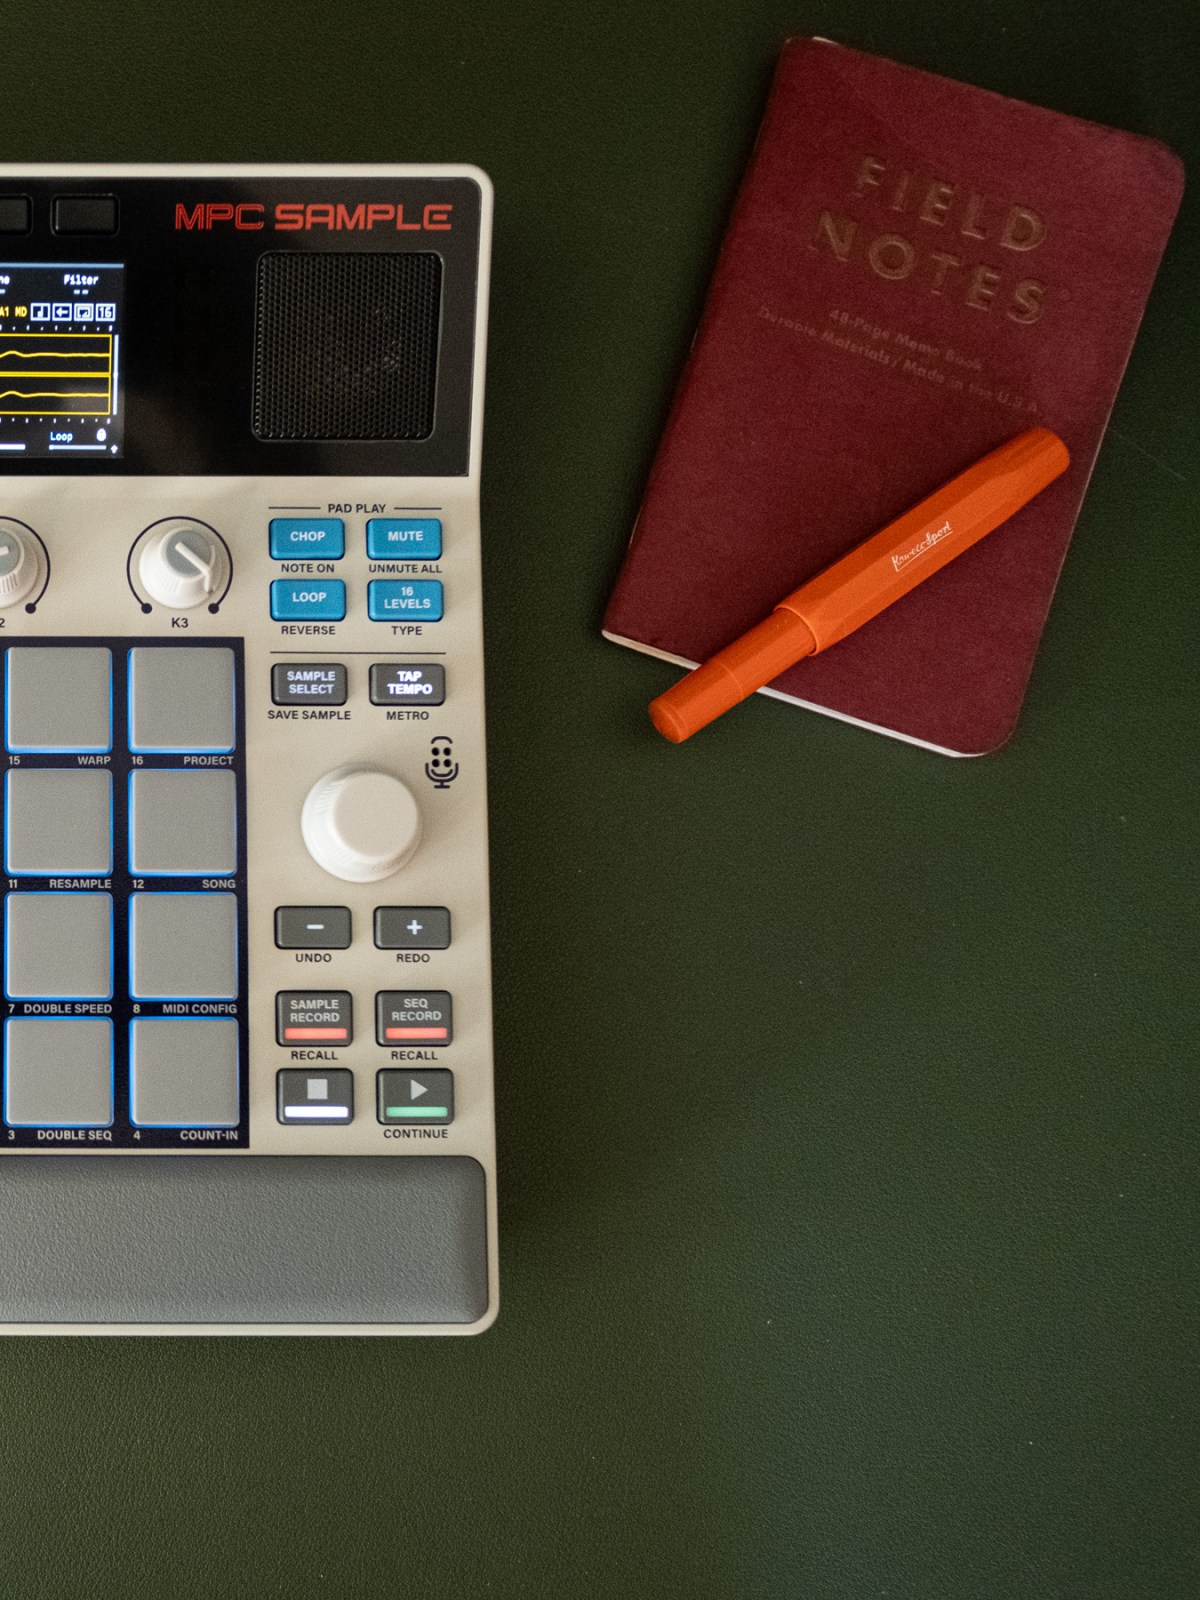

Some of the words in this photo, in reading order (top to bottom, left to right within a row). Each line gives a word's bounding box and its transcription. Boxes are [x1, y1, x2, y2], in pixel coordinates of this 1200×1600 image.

[851, 154, 1047, 252] FIELD
[175, 203, 264, 231] MPC
[275, 204, 453, 231] SAMPLE
[808, 209, 1048, 325] NOTES
[64, 274, 100, 286] Filter
[99, 306, 112, 318] 16
[50, 431, 74, 444] Loop
[328, 504, 352, 514] PAD
[355, 504, 386, 514] PLAY
[290, 531, 326, 542] CHOP
[388, 531, 424, 542] MUTE
[281, 563, 314, 573] NOTE
[316, 563, 335, 573] ON
[368, 564, 418, 574] UNMUTE
[421, 564, 442, 574] ALL
[400, 586, 414, 596] 16
[292, 592, 327, 602] LOOP
[384, 598, 431, 609] LEVELS
[171, 618, 189, 628] K3
[281, 625, 336, 636] REVERSE
[391, 626, 423, 636] TYPE
[286, 671, 336, 682] SAMPLE
[396, 670, 422, 682] TAP
[288, 684, 334, 694] SELECT
[387, 684, 433, 695] TEMPO
[268, 710, 299, 720] SAVE
[302, 710, 351, 720] SAMPLE
[386, 711, 429, 721] METRO
[8, 756, 20, 766] 15
[77, 756, 112, 766] WARP
[131, 756, 144, 766] 16
[183, 756, 234, 766] PROJECT
[8, 879, 18, 889] 11
[49, 879, 112, 889] RESAMPLE
[132, 879, 144, 889] 12
[202, 879, 236, 889] SONG
[295, 953, 332, 963] UNDO
[396, 953, 430, 963] REDO
[8, 1004, 15, 1014] 7
[23, 1004, 72, 1014] DOUBLE
[74, 1004, 112, 1014] SPEED
[133, 1004, 140, 1014] 8
[162, 1004, 189, 1014] MIDI
[191, 1004, 238, 1014] CONFIG
[290, 1000, 339, 1010] SAMPLE
[403, 998, 429, 1010] SEQ
[290, 1012, 340, 1022] RECORD
[391, 1011, 442, 1021] RECORD
[291, 1050, 338, 1060] RECALL
[391, 1050, 438, 1060] RECALL
[8, 1130, 15, 1140] 3
[37, 1130, 86, 1140] DOUBLE
[88, 1130, 112, 1140] SEQ
[133, 1130, 140, 1140] 4
[180, 1130, 239, 1140] COUNT-IN
[383, 1129, 448, 1139] CONTINUE
